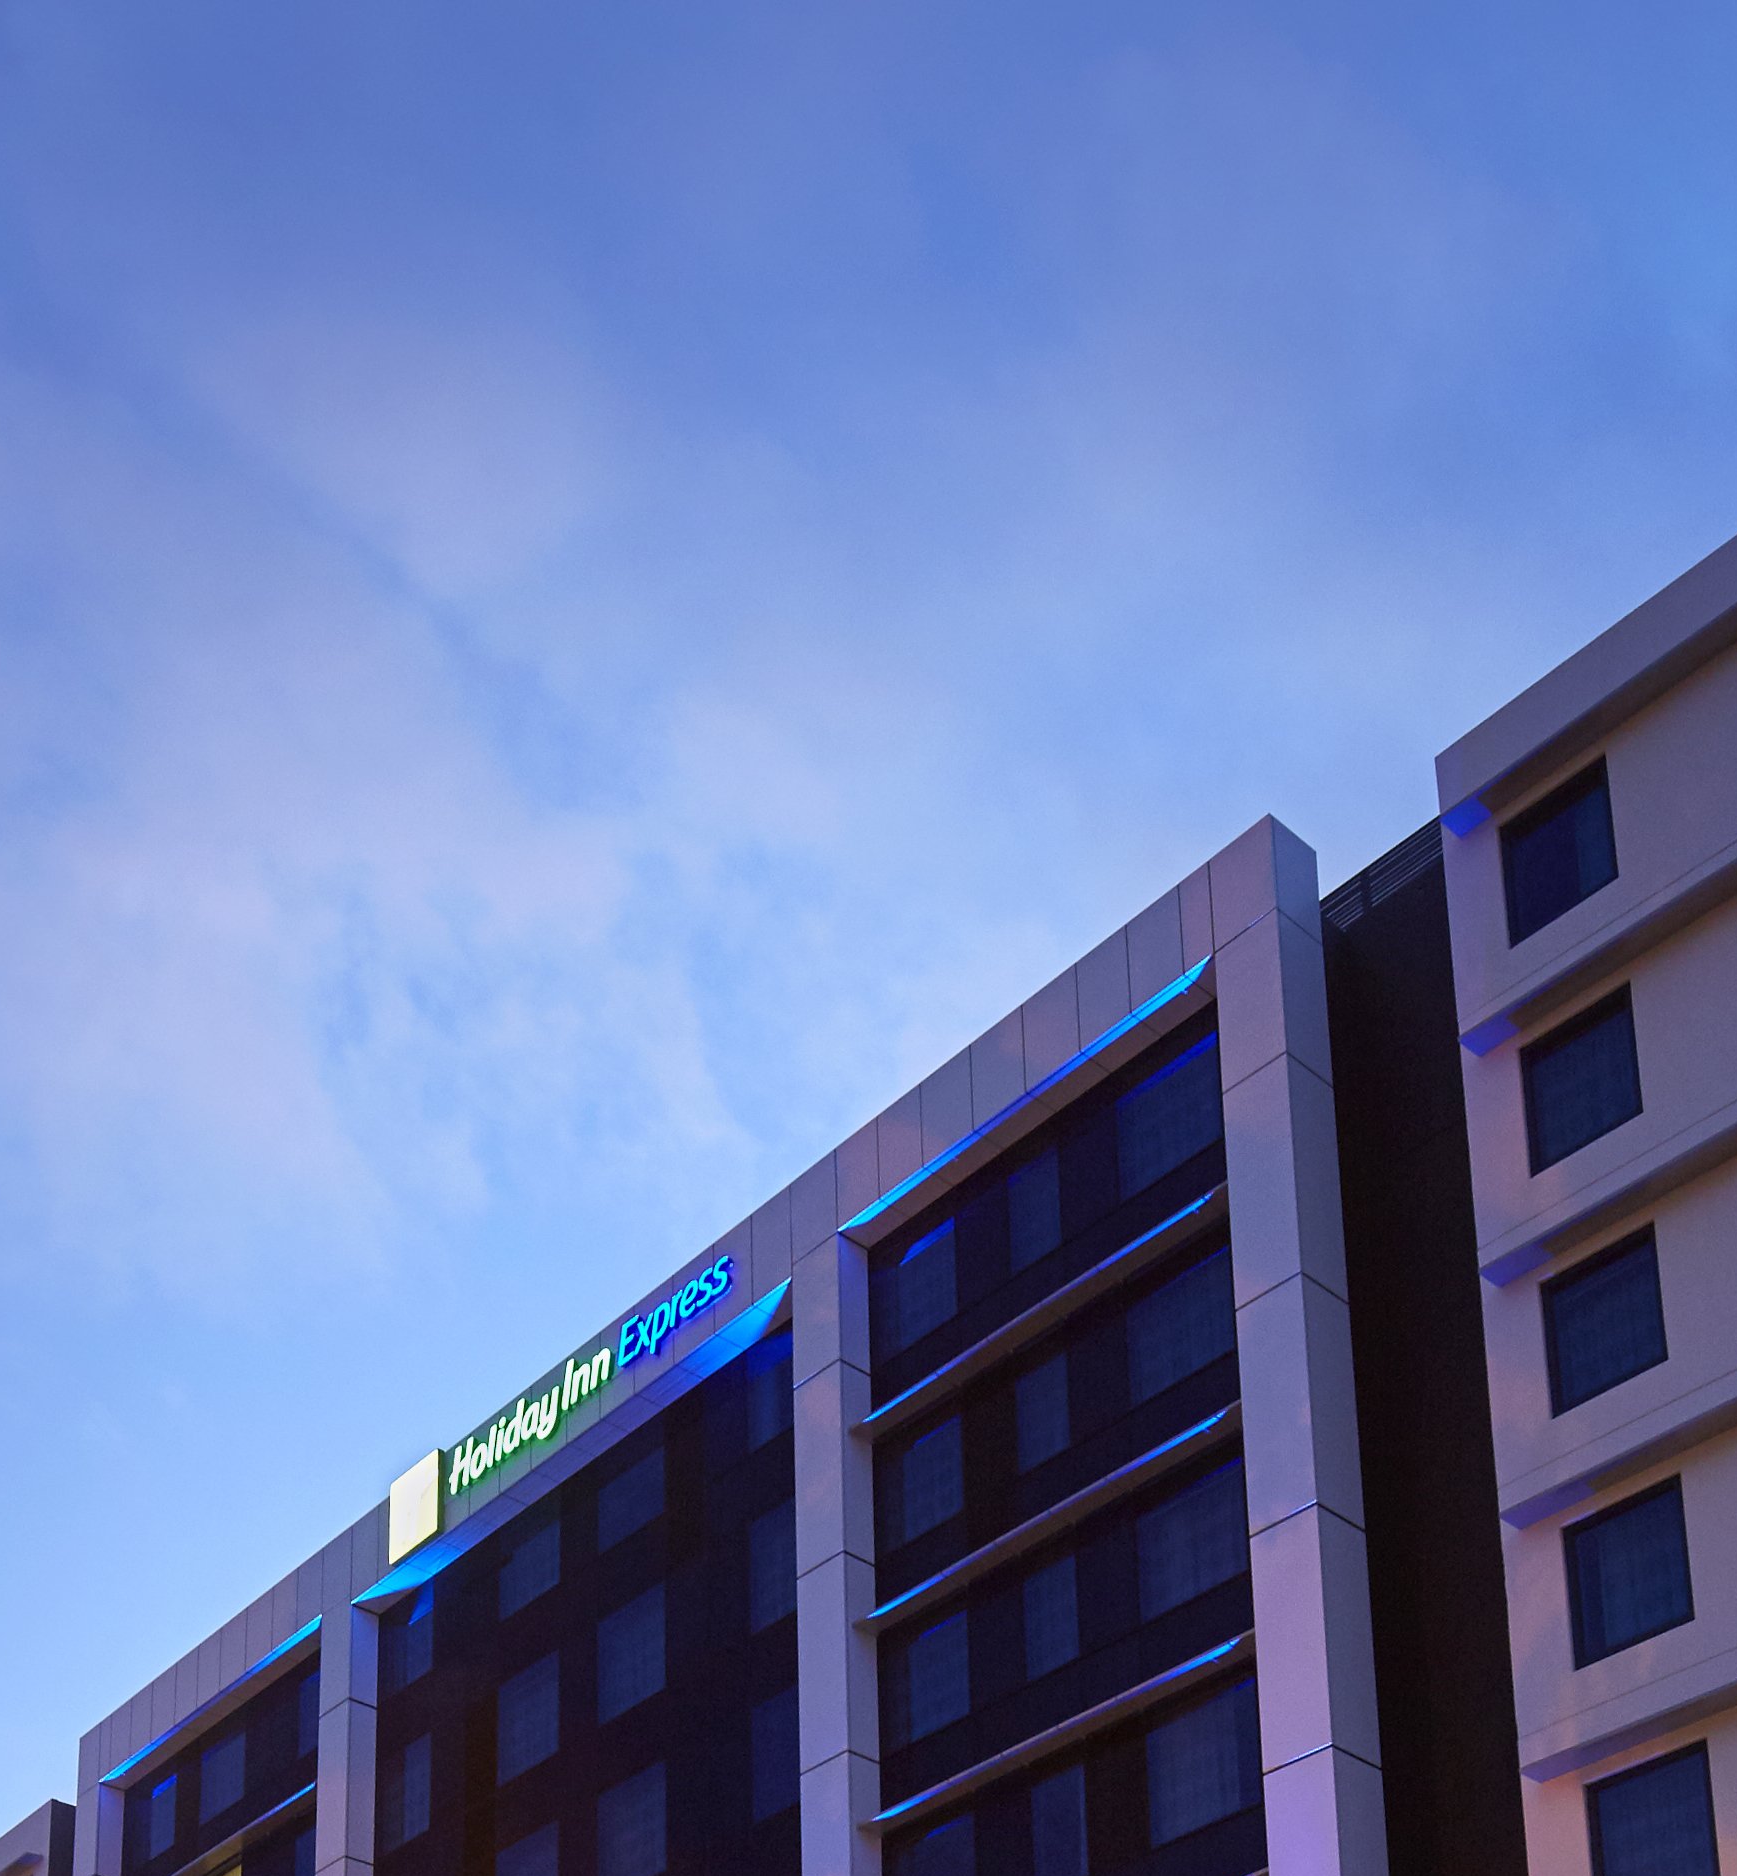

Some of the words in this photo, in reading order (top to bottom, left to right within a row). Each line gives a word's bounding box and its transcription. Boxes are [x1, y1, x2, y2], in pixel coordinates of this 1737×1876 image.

[449, 1384, 560, 1496] Holiday
[561, 1347, 611, 1412] Inn
[617, 1254, 731, 1368] Express
